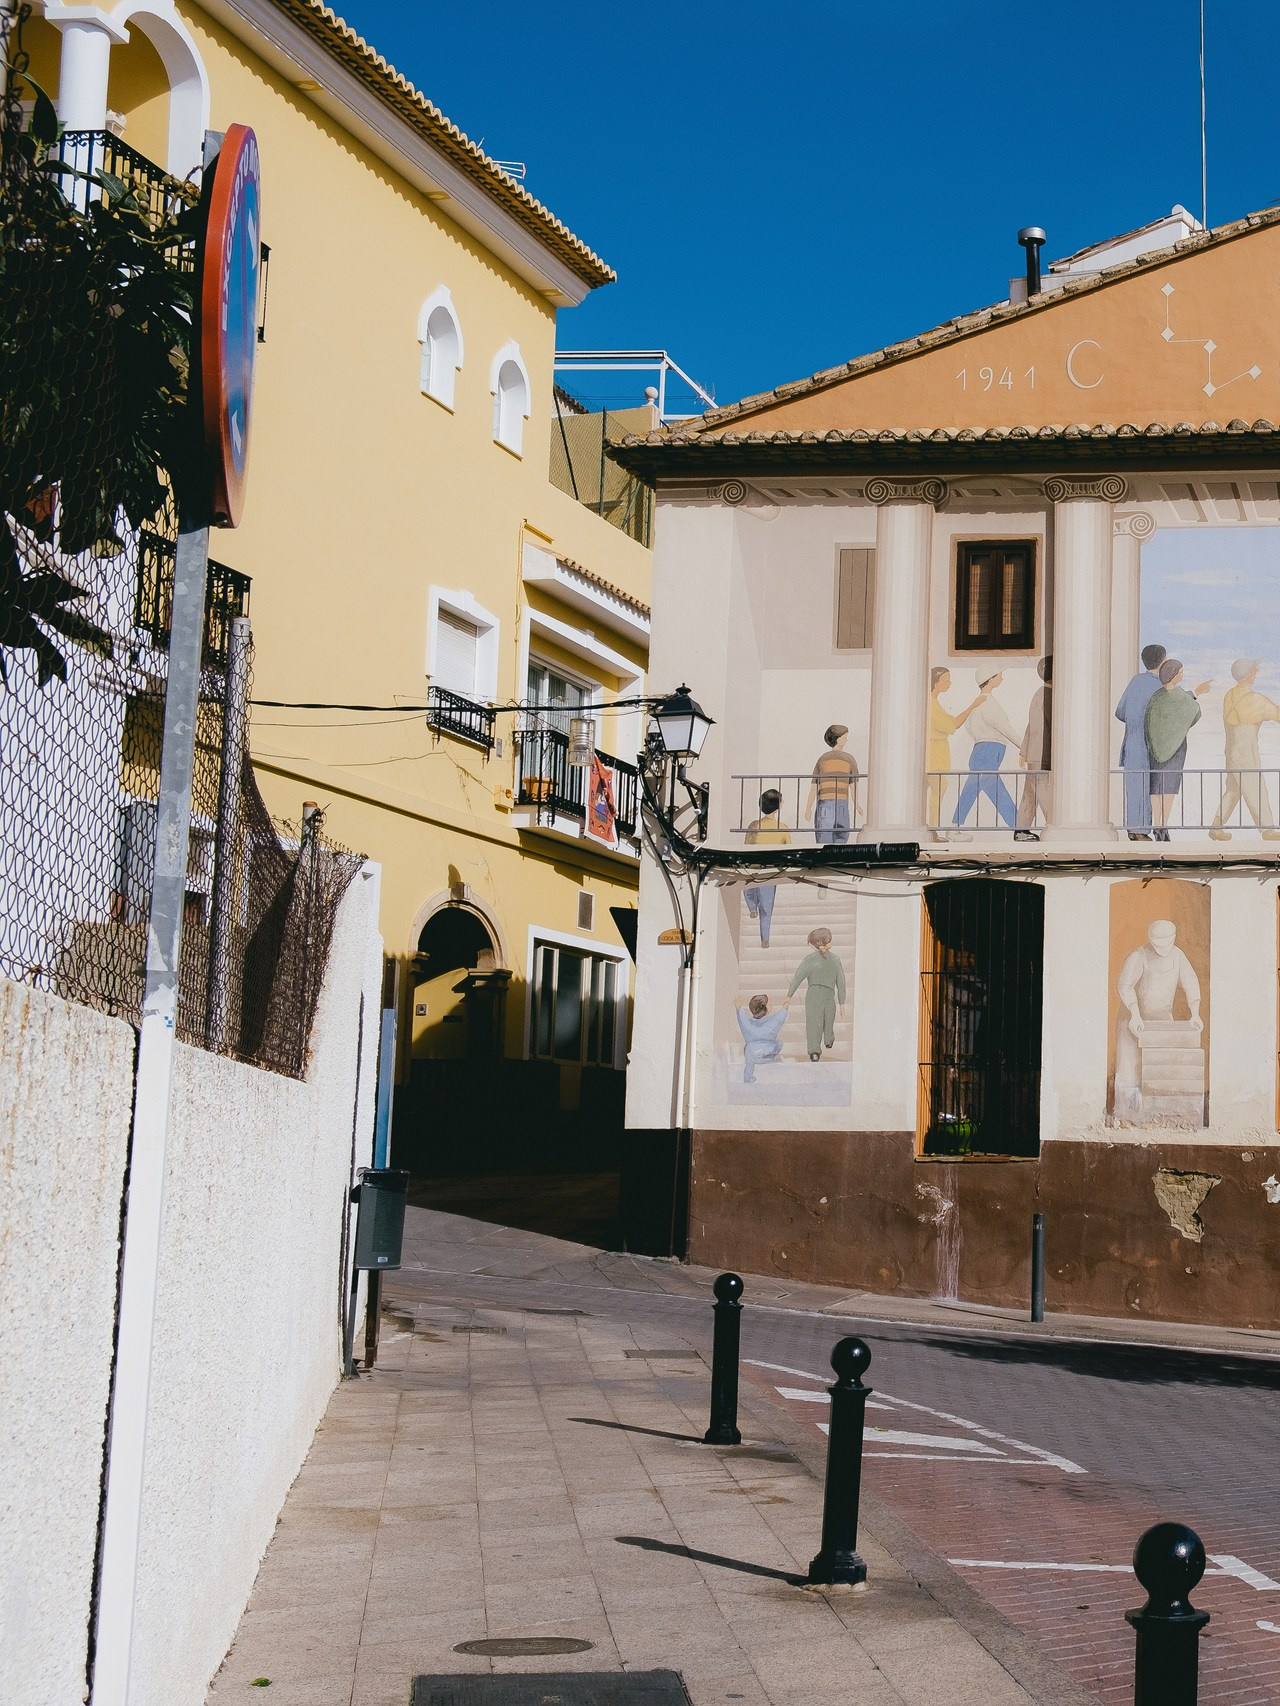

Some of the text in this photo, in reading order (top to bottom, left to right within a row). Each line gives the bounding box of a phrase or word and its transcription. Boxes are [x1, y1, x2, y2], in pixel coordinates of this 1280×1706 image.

[222, 143, 249, 332] EXCEPTO
[955, 365, 1035, 392] 1941
[1066, 339, 1104, 389] C
